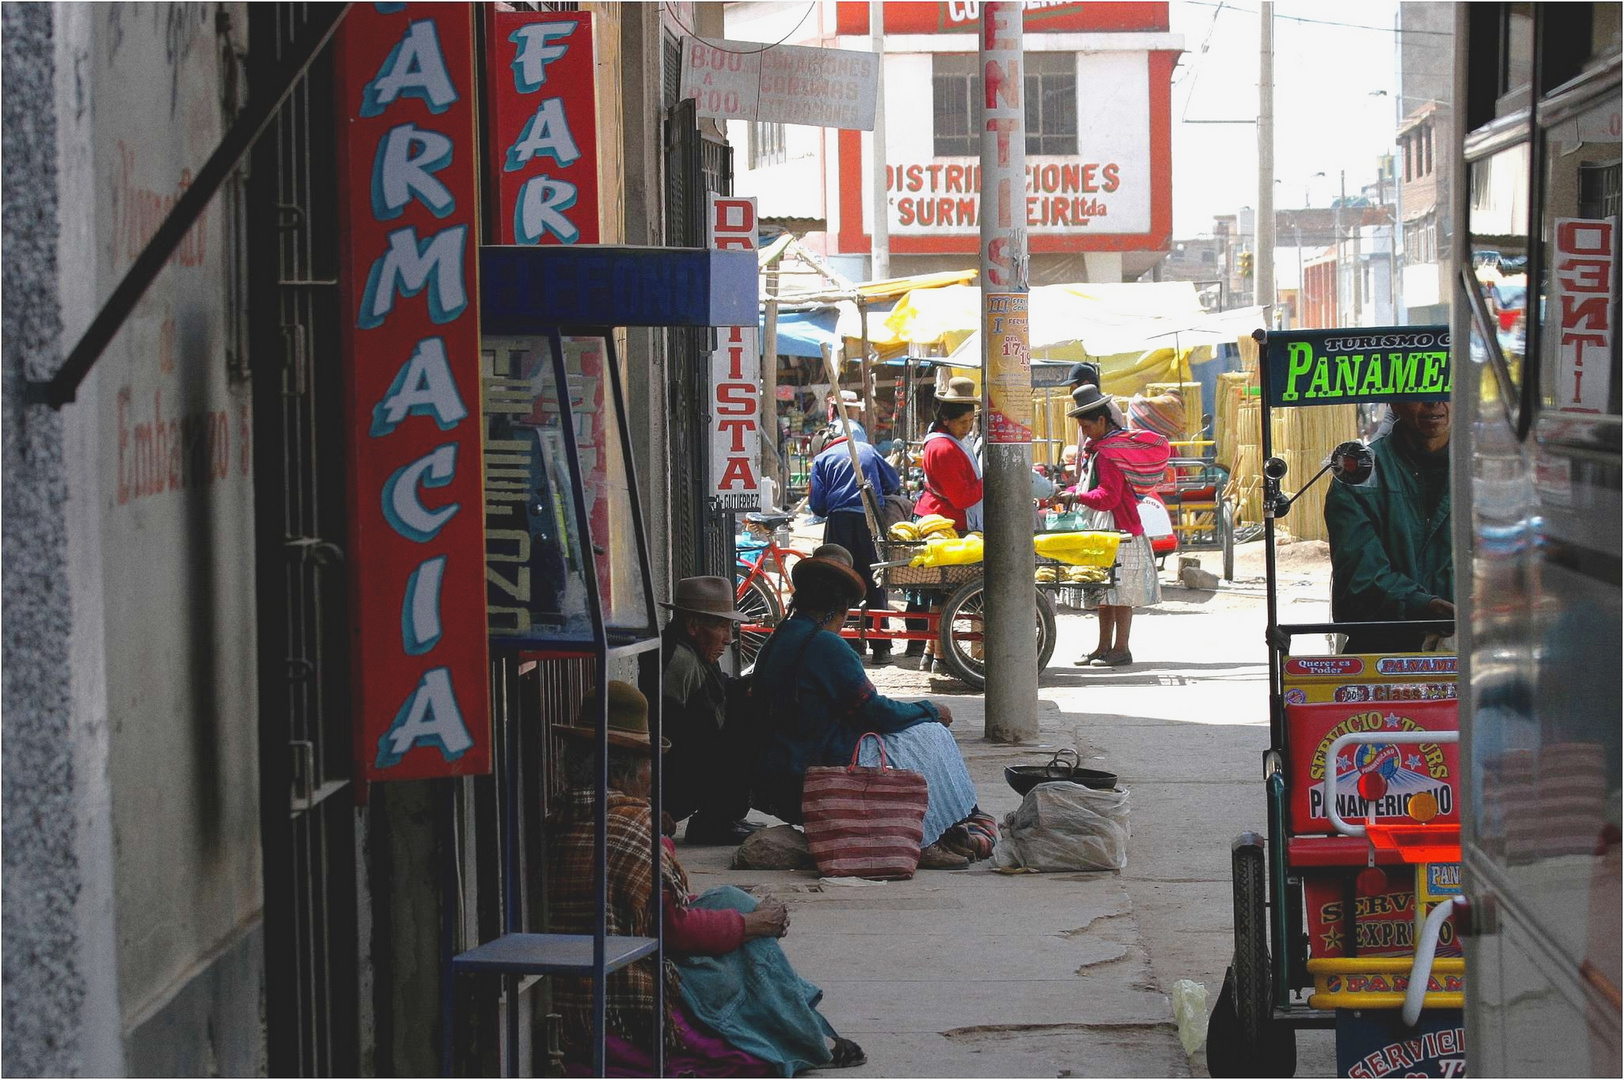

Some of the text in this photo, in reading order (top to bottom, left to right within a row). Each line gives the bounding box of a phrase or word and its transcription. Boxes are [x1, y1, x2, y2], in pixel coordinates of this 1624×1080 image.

[691, 44, 742, 72] 8:00
[503, 20, 582, 244] FAR
[1003, 343, 1020, 356] 17
[1325, 333, 1433, 351] TURISMO
[359, 2, 475, 768] ARMACIA
[1282, 341, 1455, 401] PANAME
[117, 385, 229, 507] Embarzo
[1298, 660, 1336, 668] Querer
[1373, 685, 1422, 701] Class
[1310, 785, 1452, 819] PNAMERICNO
[1356, 919, 1454, 949] EXPRO
